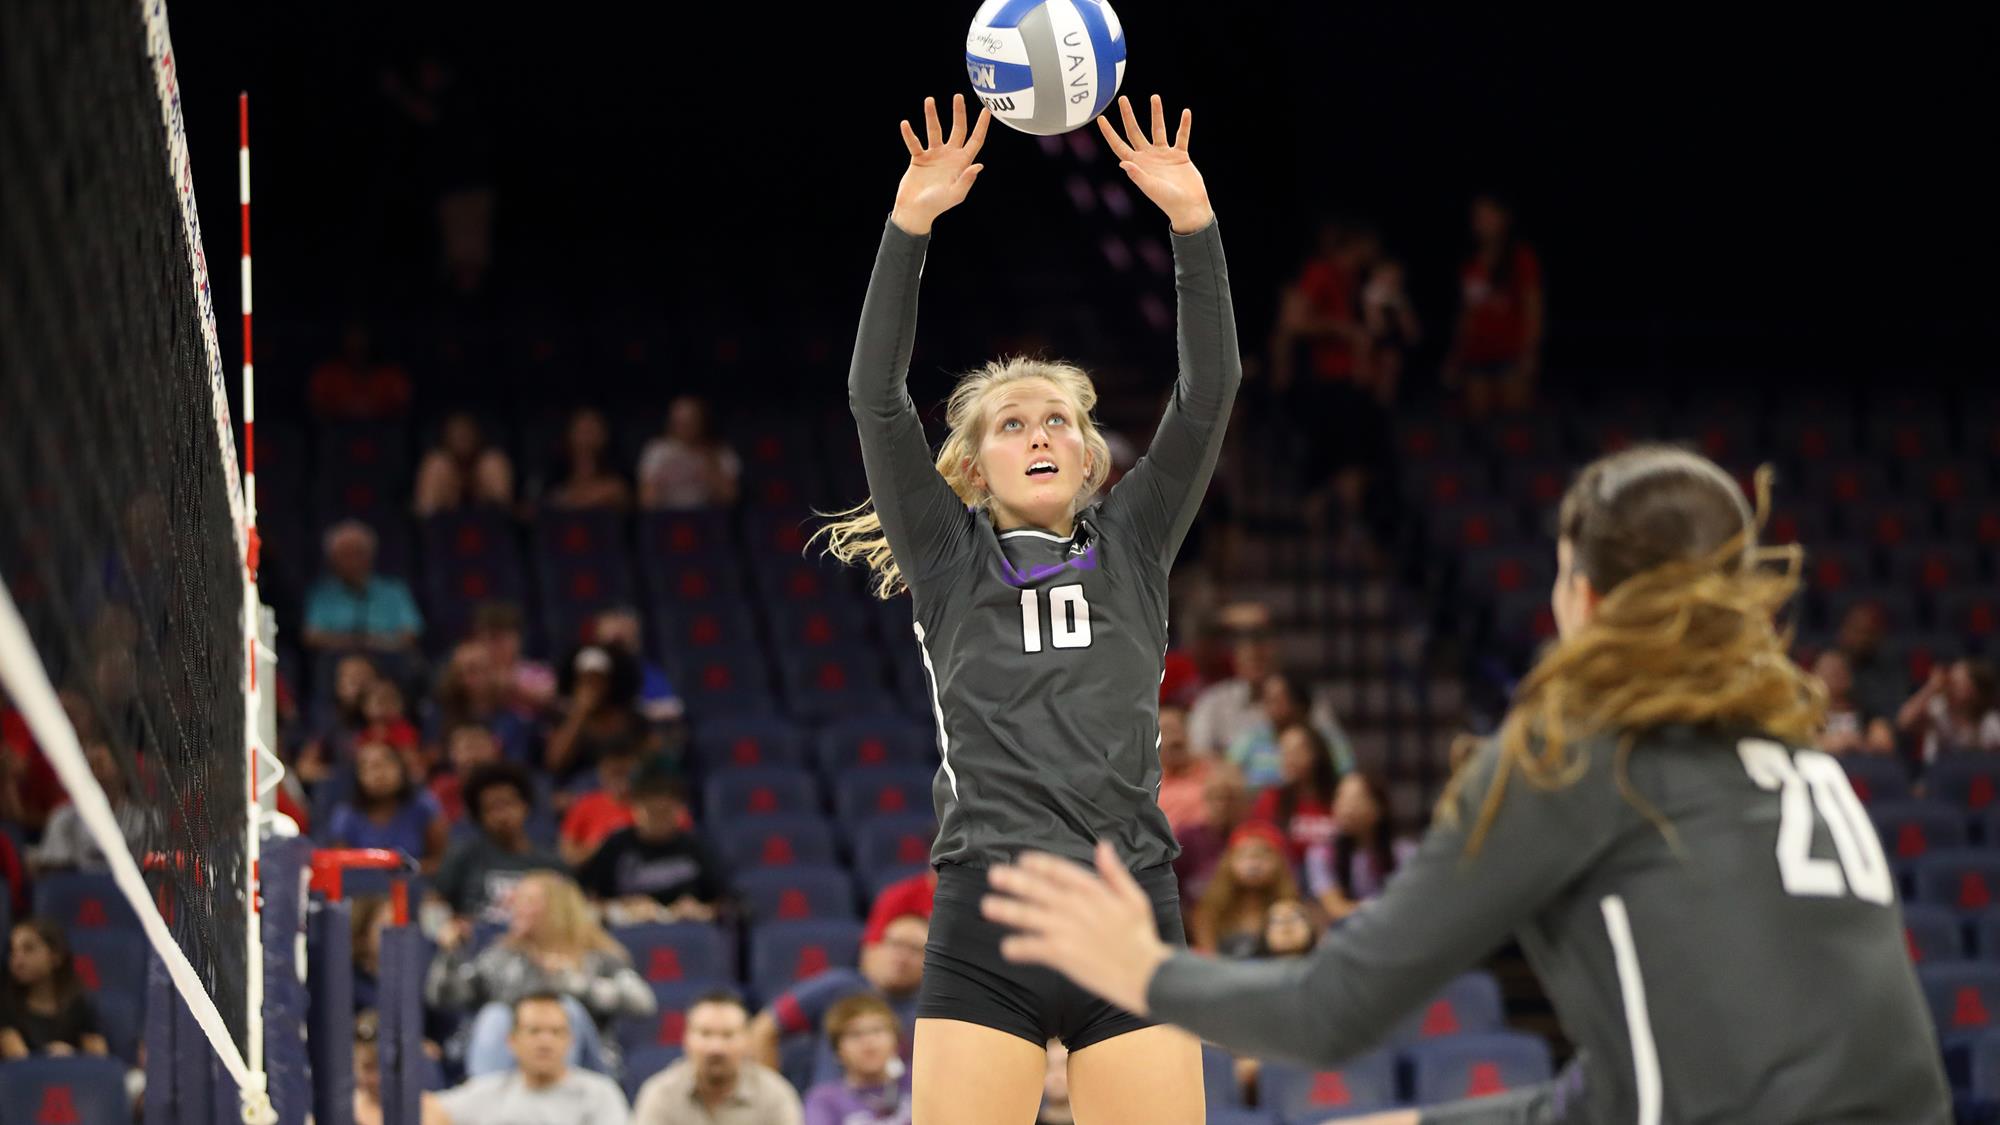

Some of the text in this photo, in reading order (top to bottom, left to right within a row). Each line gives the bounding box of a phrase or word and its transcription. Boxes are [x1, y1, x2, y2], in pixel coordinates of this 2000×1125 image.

[1063, 31, 1090, 105] UAVB
[1020, 584, 1092, 653] 10
[1735, 737, 1894, 906] 20
